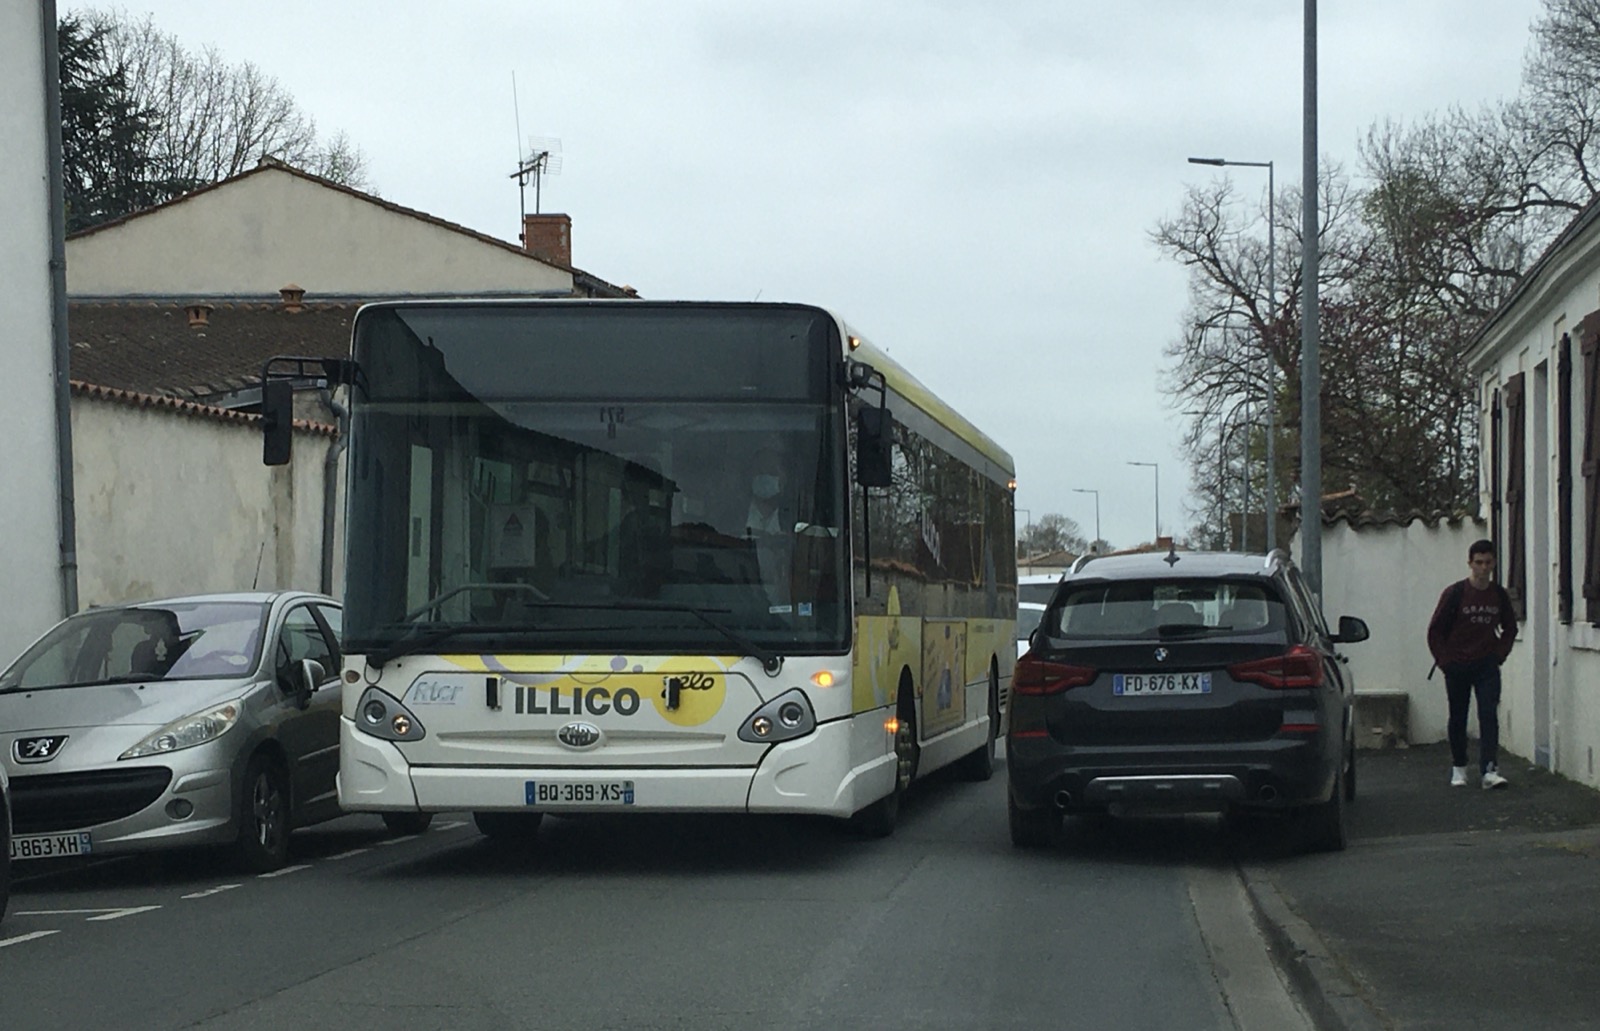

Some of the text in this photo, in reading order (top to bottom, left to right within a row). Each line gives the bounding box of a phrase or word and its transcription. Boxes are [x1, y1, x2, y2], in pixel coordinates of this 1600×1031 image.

[1462, 605, 1499, 614] GRAND
[1470, 616, 1492, 624] CRU
[1125, 675, 1199, 691] FD-676-KX
[515, 687, 640, 716] ILLICO
[539, 784, 620, 801] BQ-369-XS
[10, 836, 79, 857] J-863-XH
